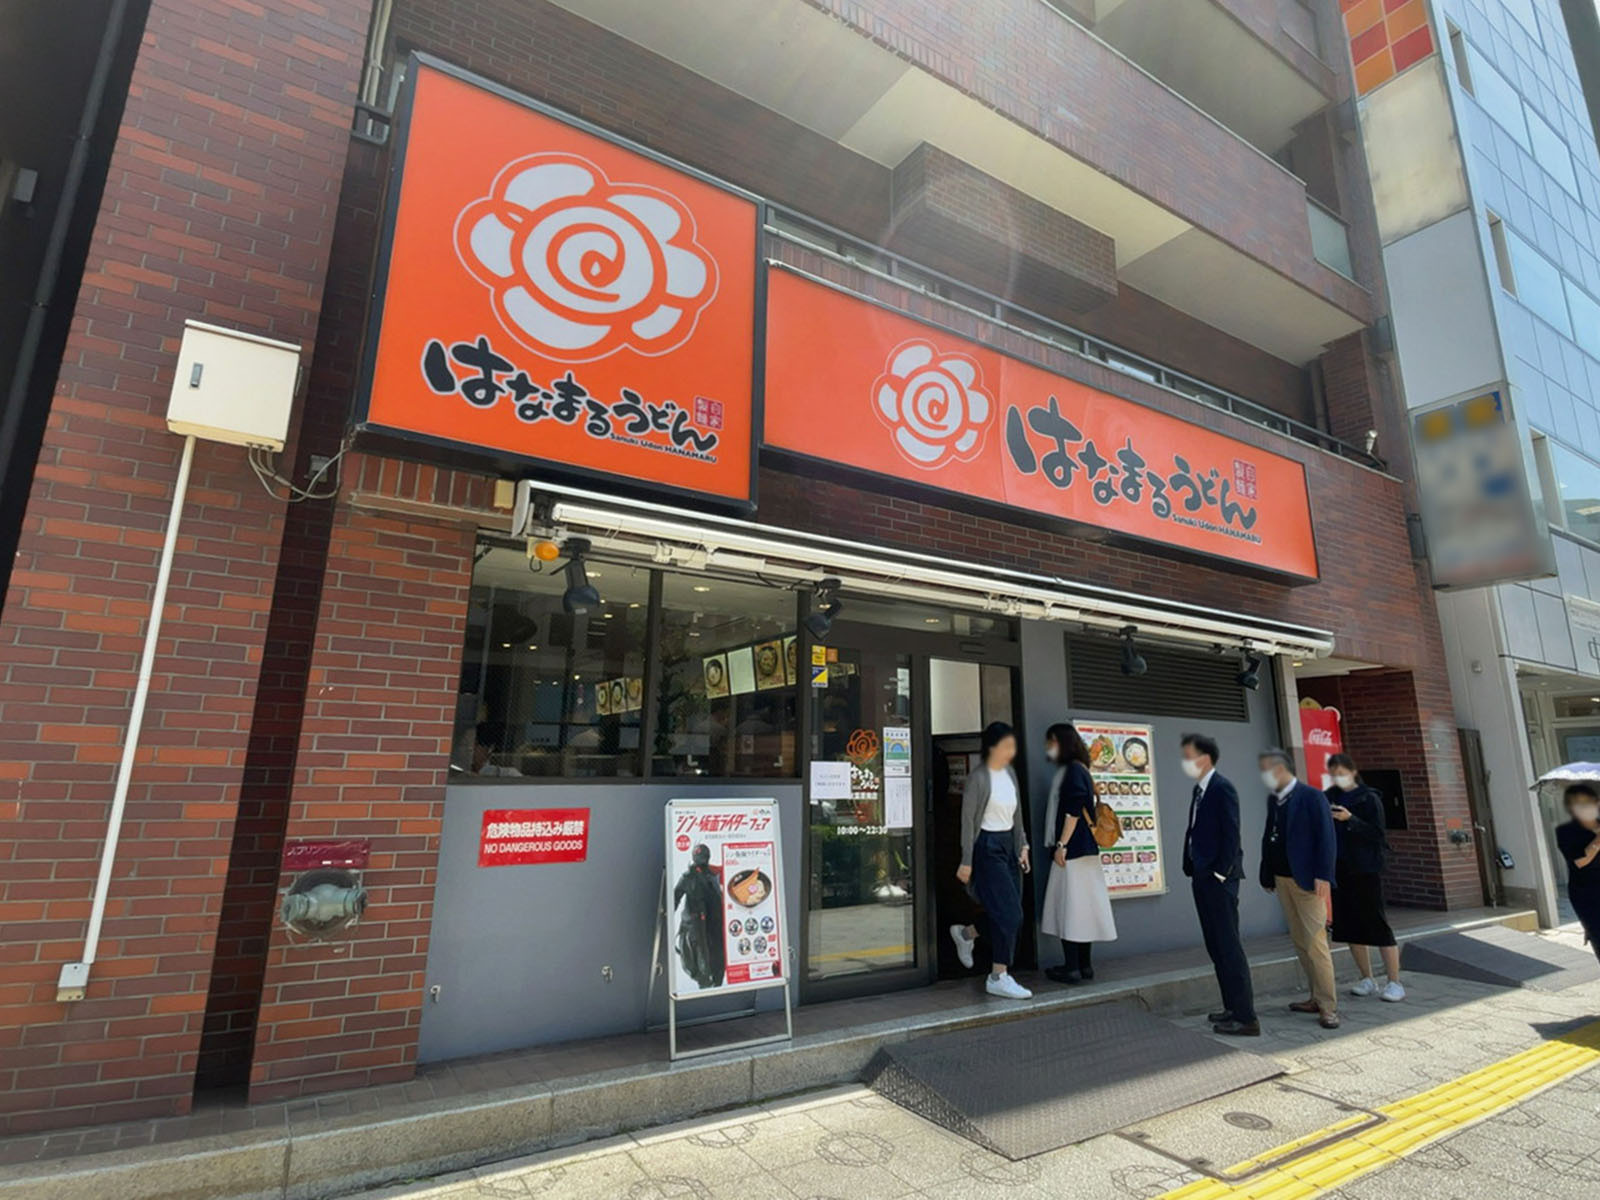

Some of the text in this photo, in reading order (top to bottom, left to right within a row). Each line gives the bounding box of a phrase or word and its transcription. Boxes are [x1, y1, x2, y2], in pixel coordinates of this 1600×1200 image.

[422, 335, 717, 452] はなまるうどん
[610, 432, 638, 444] Sanuki
[664, 446, 717, 462] HANAMARU
[1006, 395, 1257, 530] はなまるうどん
[483, 840, 583, 854] NO DANGEROUS GOODS
